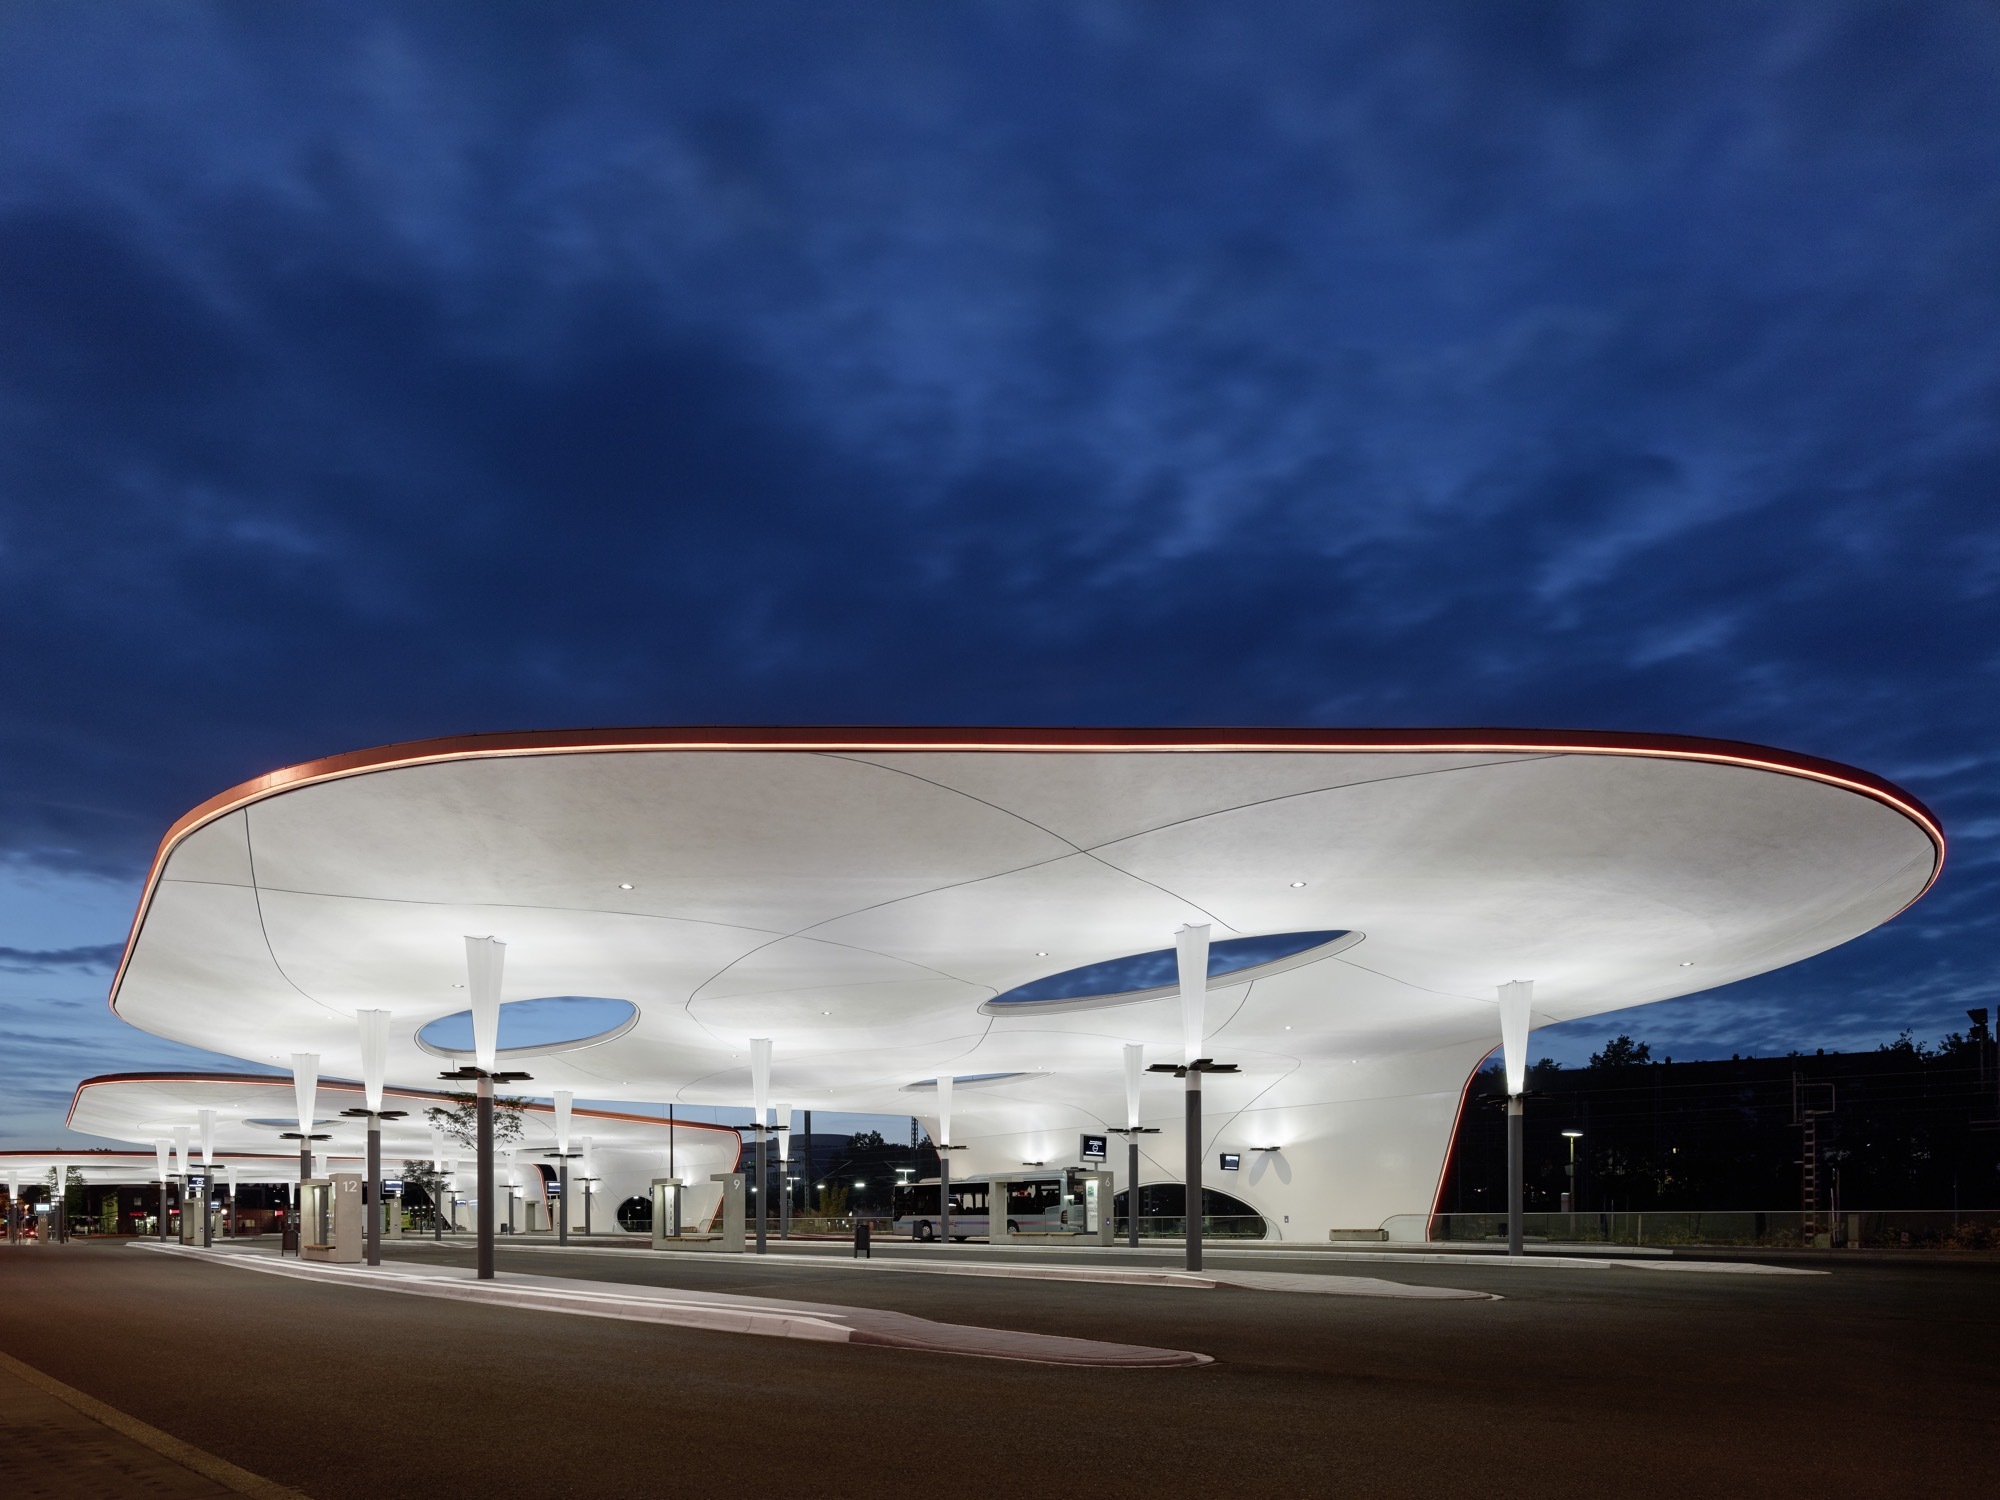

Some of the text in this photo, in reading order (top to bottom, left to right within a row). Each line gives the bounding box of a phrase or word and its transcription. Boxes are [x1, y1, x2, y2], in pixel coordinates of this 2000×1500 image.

[342, 1180, 358, 1192] 12
[734, 1180, 740, 1190] 9
[1105, 1176, 1110, 1186] 6
